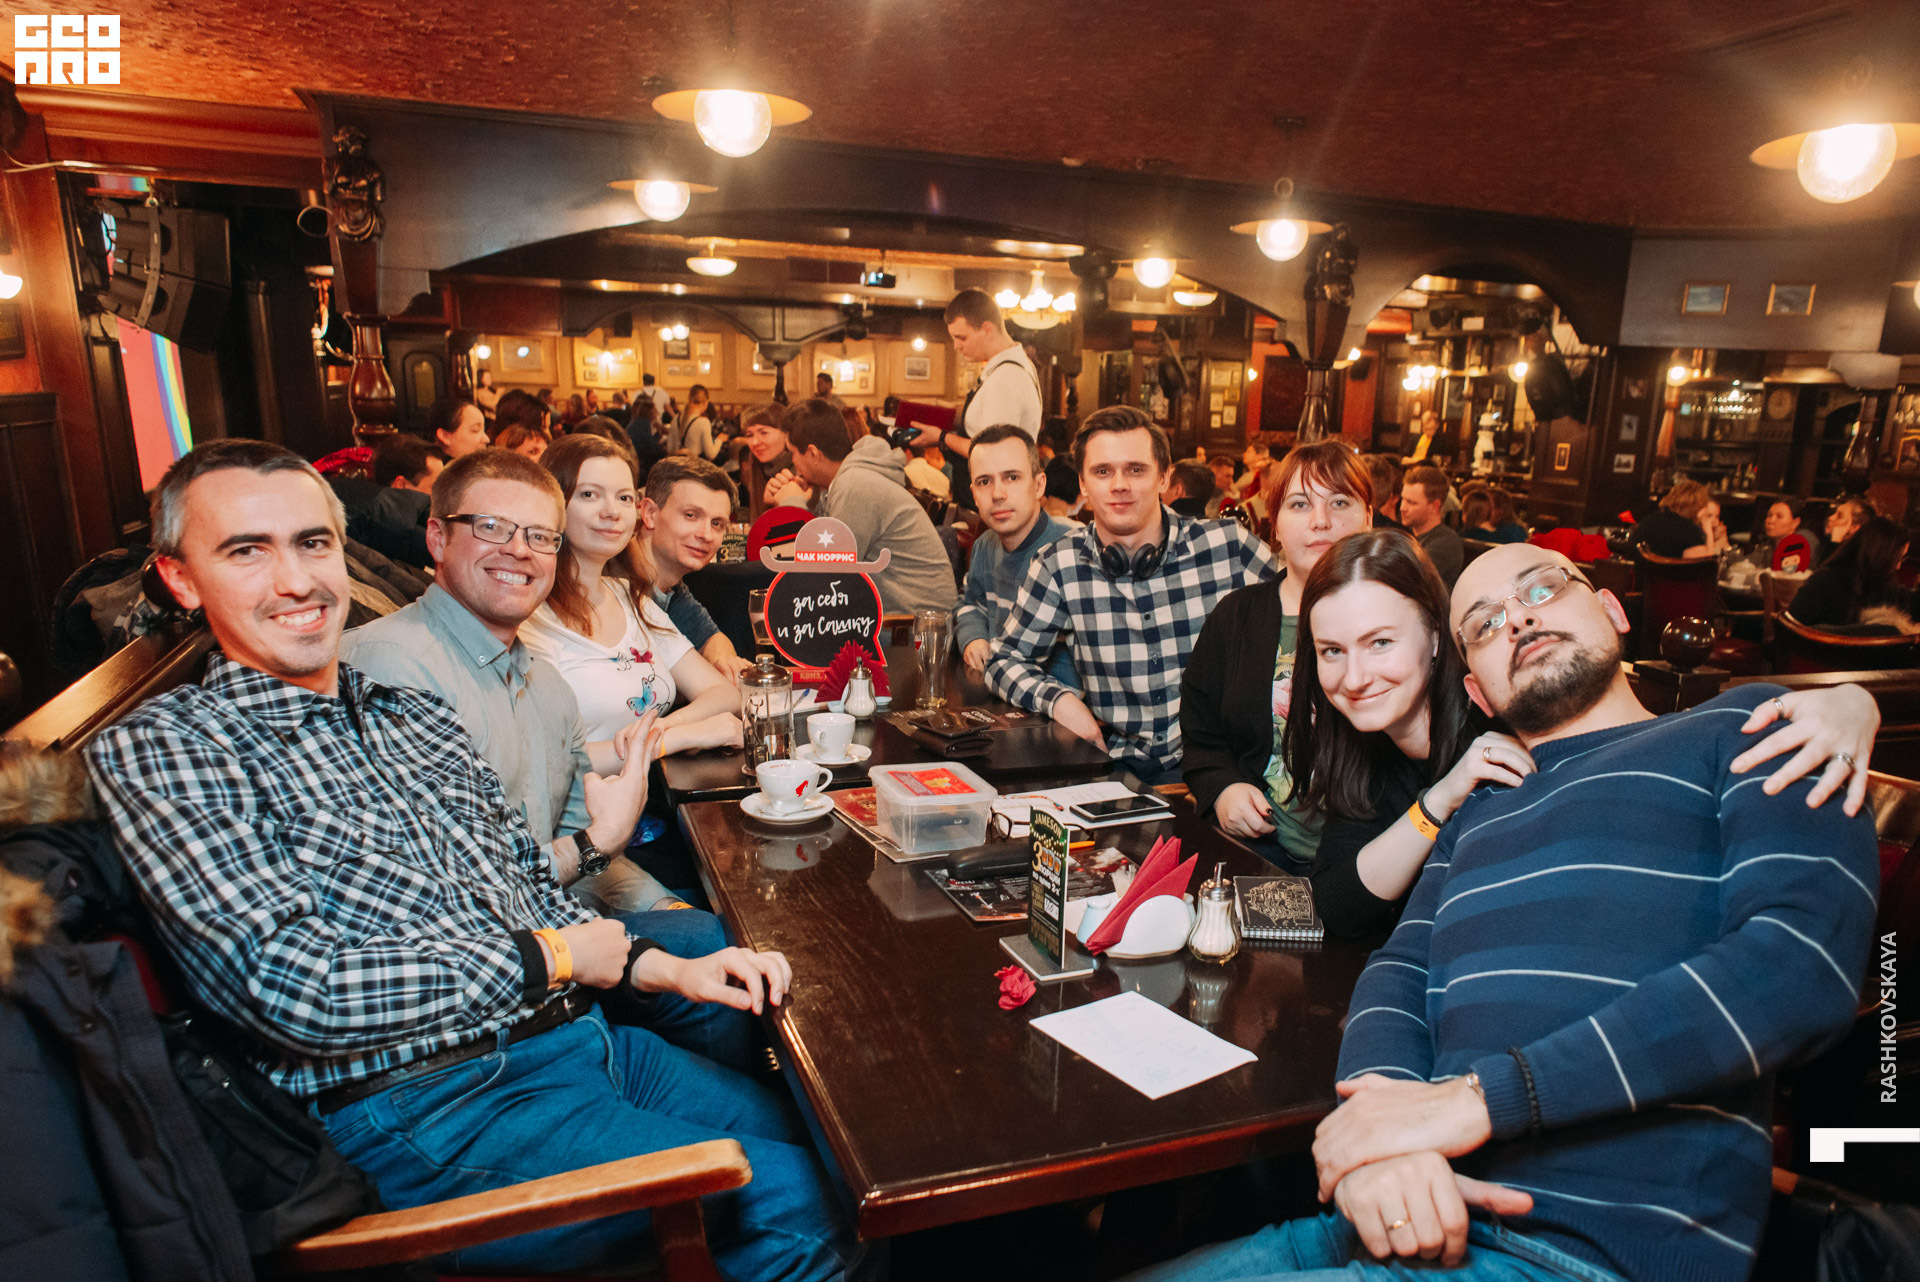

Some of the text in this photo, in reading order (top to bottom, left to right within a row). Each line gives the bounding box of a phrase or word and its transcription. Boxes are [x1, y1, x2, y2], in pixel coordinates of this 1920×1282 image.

[720, 548, 729, 562] 3
[797, 553, 855, 562] ЧАК НОРРИС
[793, 580, 849, 617] за себя
[777, 616, 875, 644] и за Сашку
[1035, 814, 1062, 838] JAMESON
[1032, 841, 1042, 871] 3
